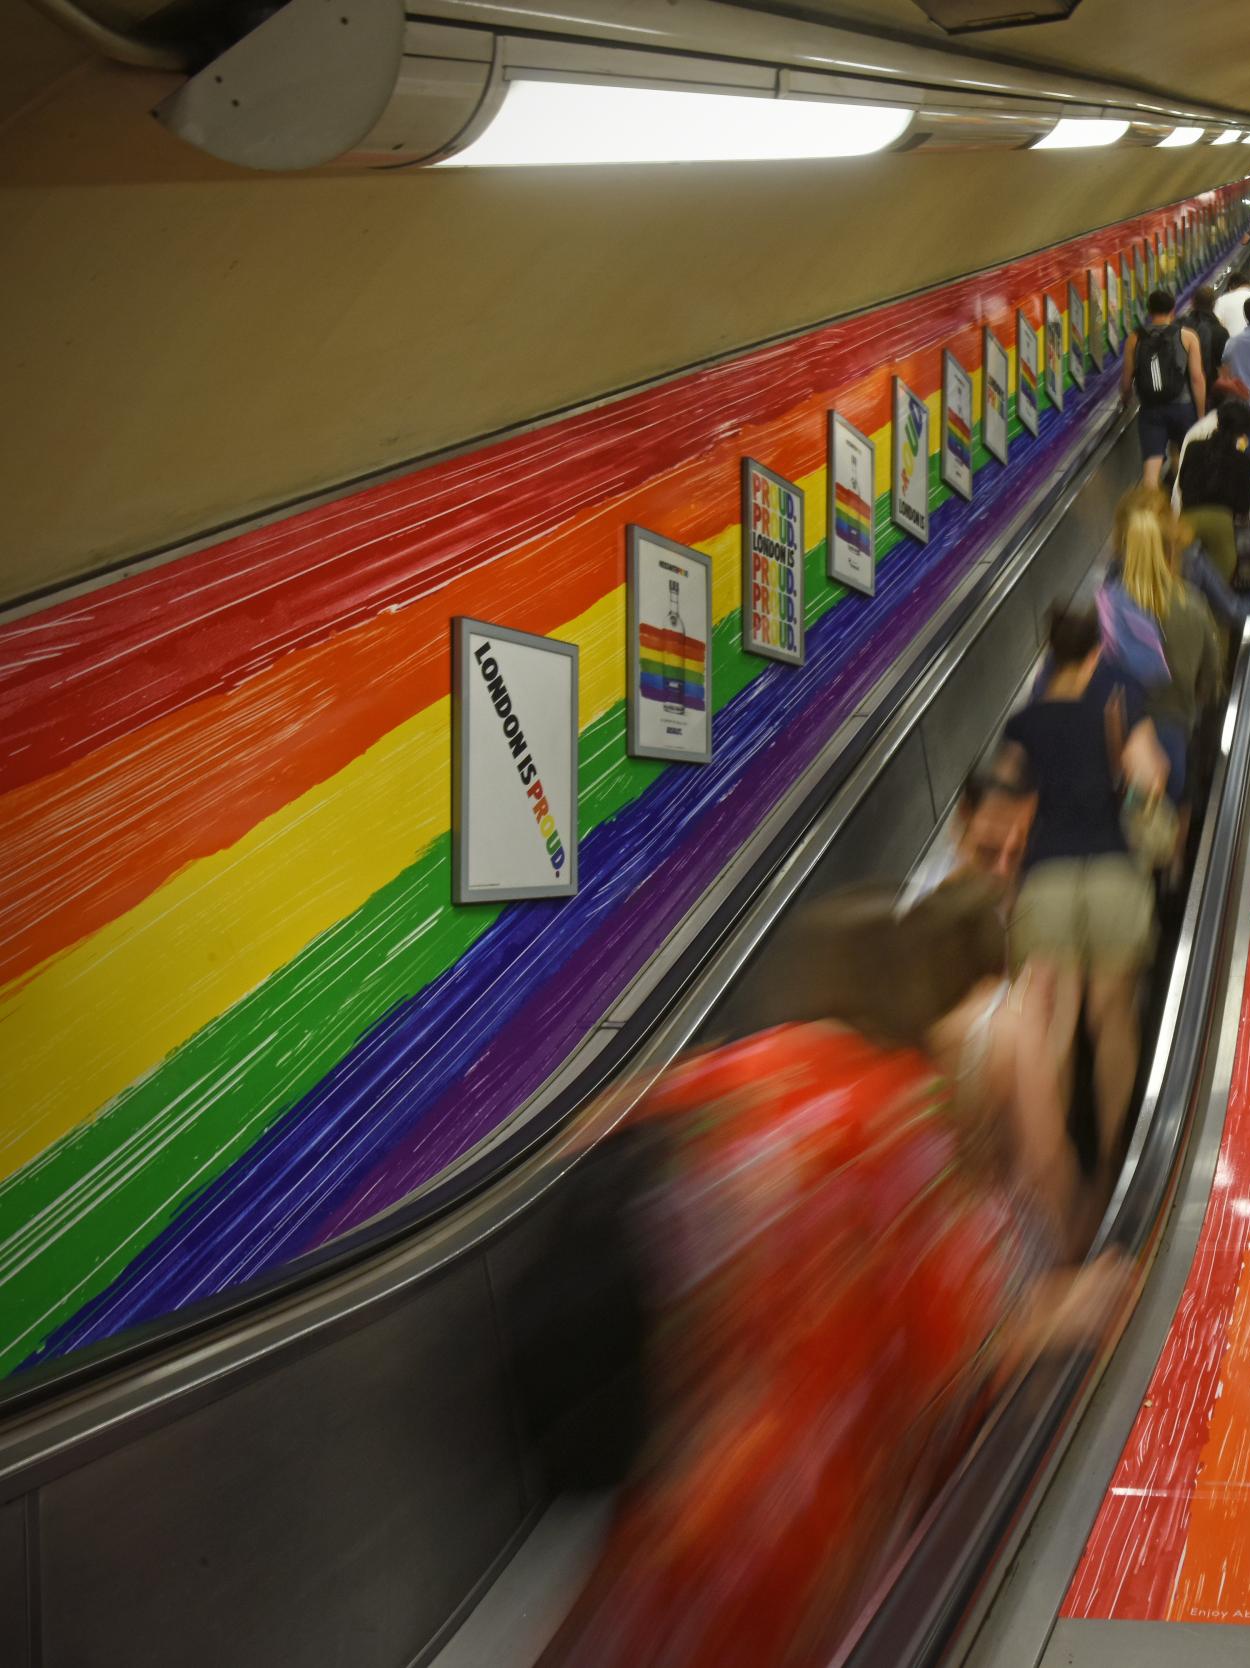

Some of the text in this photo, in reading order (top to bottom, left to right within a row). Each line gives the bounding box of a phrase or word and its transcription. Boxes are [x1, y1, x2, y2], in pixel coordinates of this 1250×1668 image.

[753, 471, 797, 522] PROUD.
[753, 501, 797, 550] PROUD.
[753, 531, 795, 568] LONDON IS
[753, 551, 797, 597] PROUD.
[753, 580, 797, 624] PROUD.
[753, 612, 797, 652] PROUD.
[473, 641, 566, 878] LONDON IS PROUD.
[1190, 1607, 1229, 1620] Enjoy
